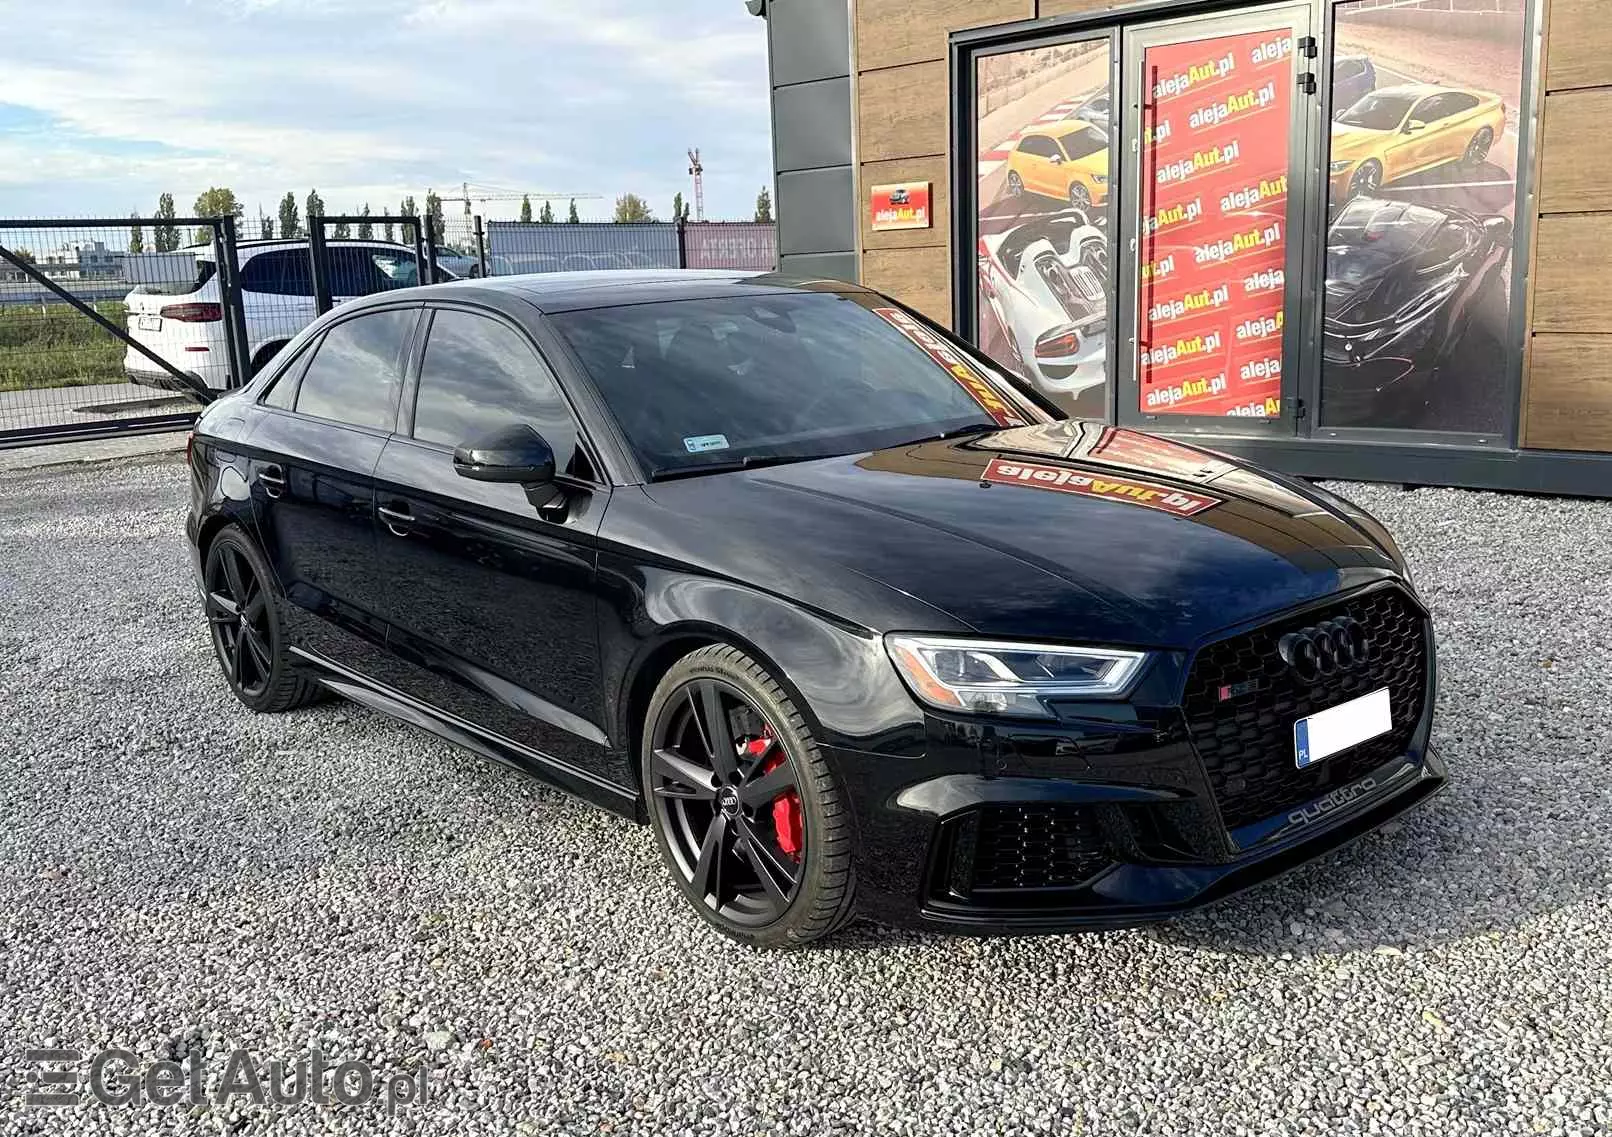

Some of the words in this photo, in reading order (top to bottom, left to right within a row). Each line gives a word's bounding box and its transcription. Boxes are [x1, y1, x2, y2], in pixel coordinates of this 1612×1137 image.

[1153, 52, 1235, 99] alejaAut.pl
[1188, 82, 1275, 129] alejaAut.pl
[1156, 140, 1240, 184] alejaAut.pl
[875, 206, 926, 224] alejaAut.pl
[1194, 223, 1280, 263] alejaAut.pl
[1243, 268, 1284, 292] aleja
[1149, 285, 1229, 321] alejaAut.pl
[1141, 331, 1221, 365] alejaAut.pl
[1240, 357, 1281, 379] aleja
[1147, 373, 1226, 406] alejaAut.pl
[1298, 749, 1308, 760] PL
[1288, 777, 1377, 824] quattro
